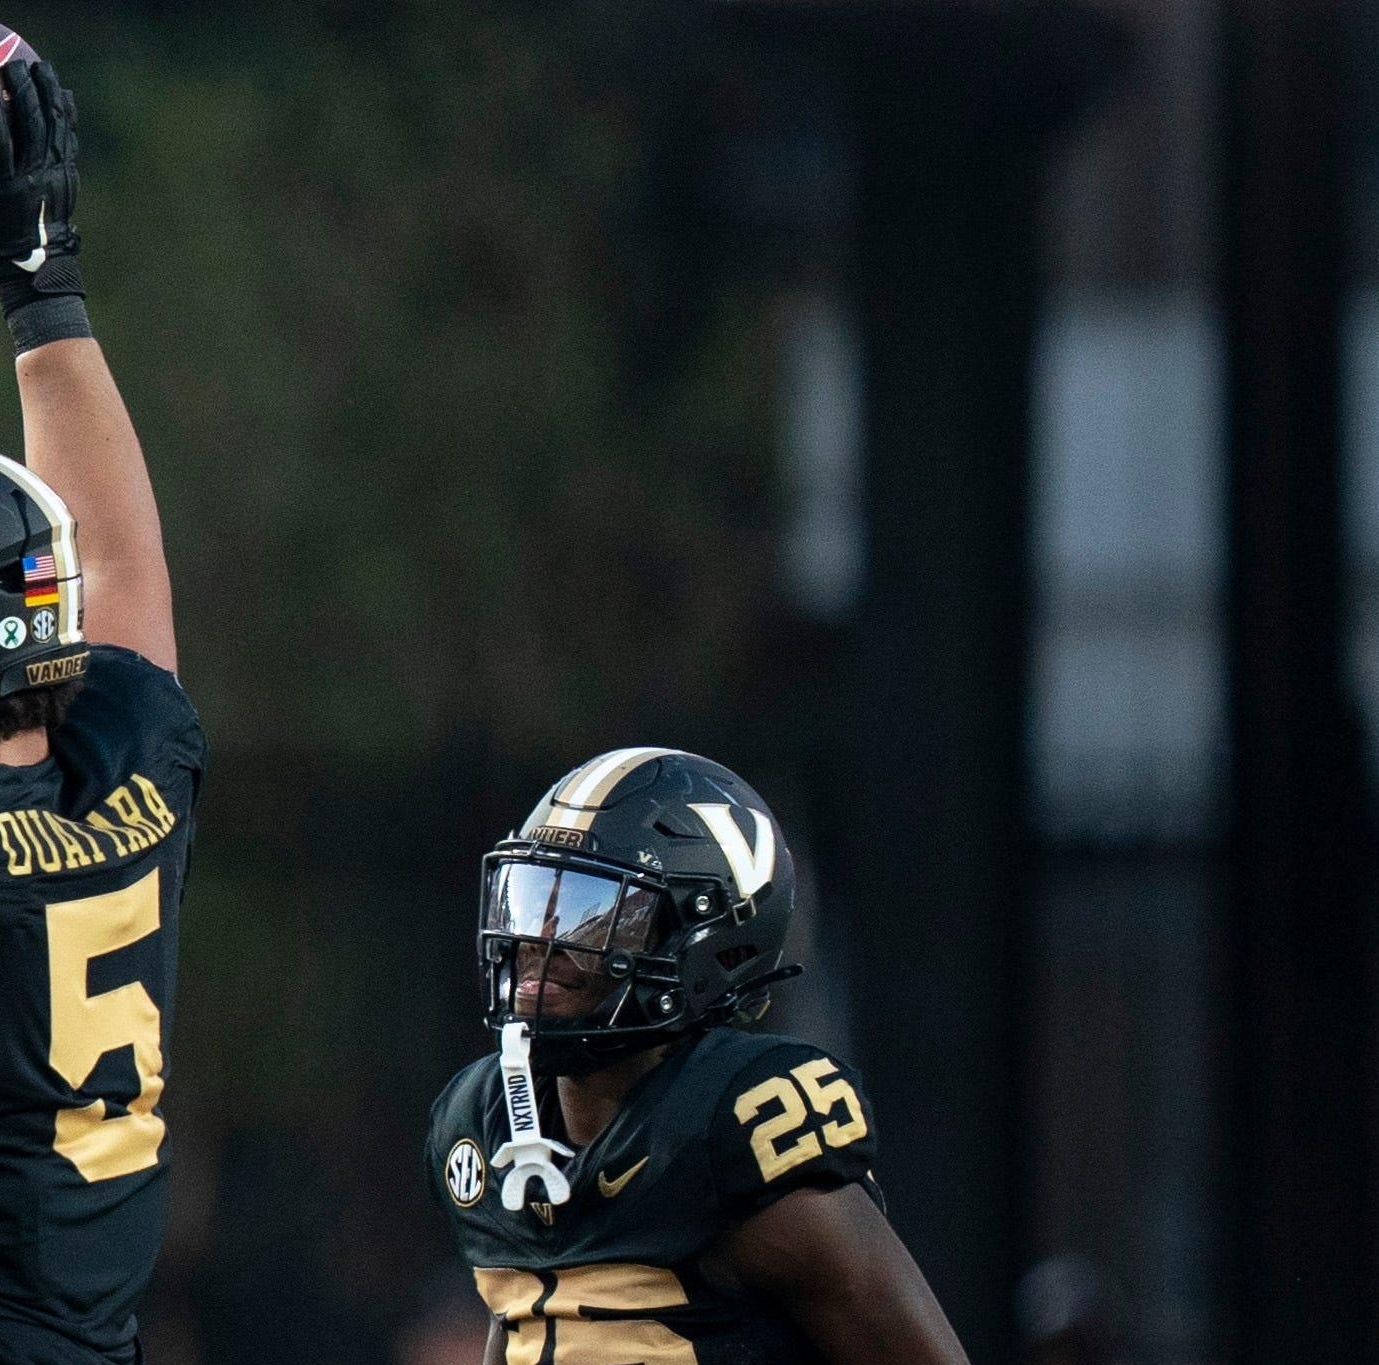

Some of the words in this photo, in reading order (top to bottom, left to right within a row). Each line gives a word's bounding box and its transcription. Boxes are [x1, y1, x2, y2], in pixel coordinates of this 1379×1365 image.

[32, 609, 55, 641] SEC
[687, 803, 776, 899] V
[45, 867, 165, 1182] 5
[507, 1074, 534, 1132] NXTRND
[734, 1057, 867, 1183] 25
[449, 1143, 482, 1202] SEC
